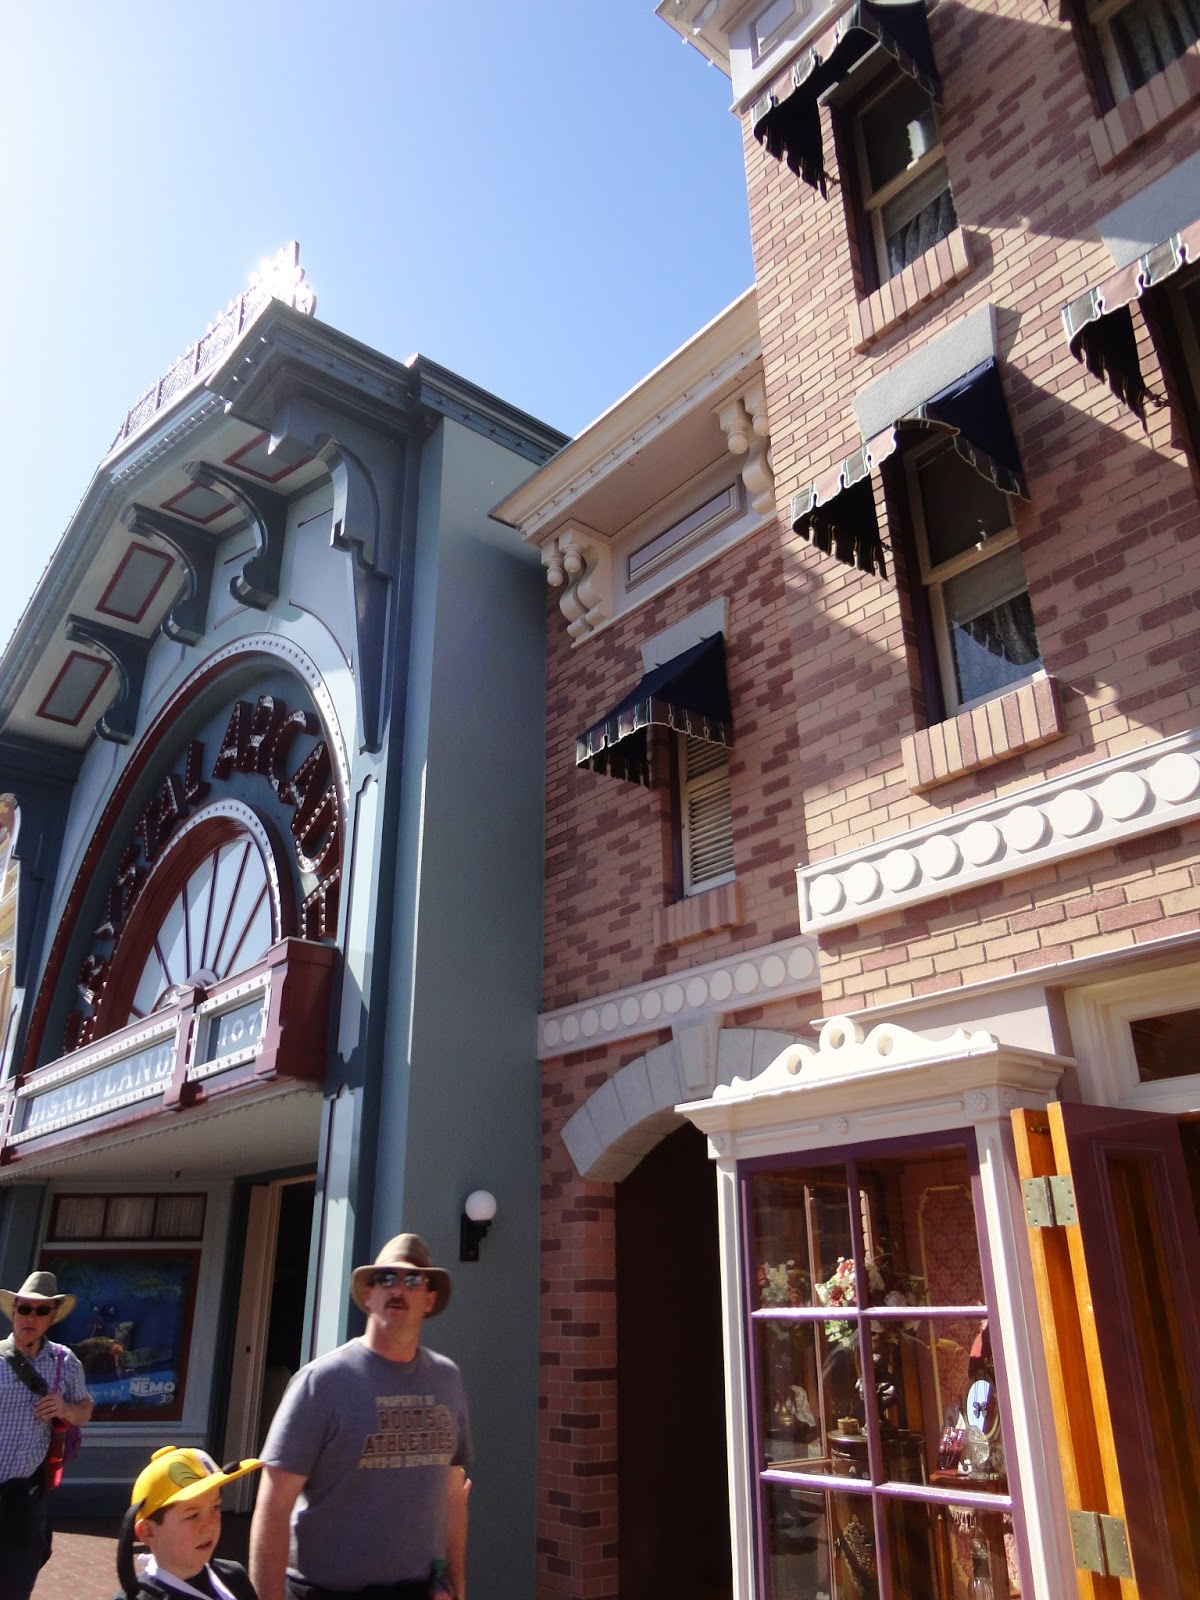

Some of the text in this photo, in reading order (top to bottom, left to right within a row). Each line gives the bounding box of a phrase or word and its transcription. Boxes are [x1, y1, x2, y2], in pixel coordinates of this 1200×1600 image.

[212, 695, 341, 942] ARCADE
[221, 1012, 259, 1046] 107
[28, 1046, 170, 1126] DISNEYLAND
[130, 1380, 176, 1394] NEMO
[377, 1407, 436, 1431] ROOTS
[363, 1430, 456, 1456] ATHLETICS
